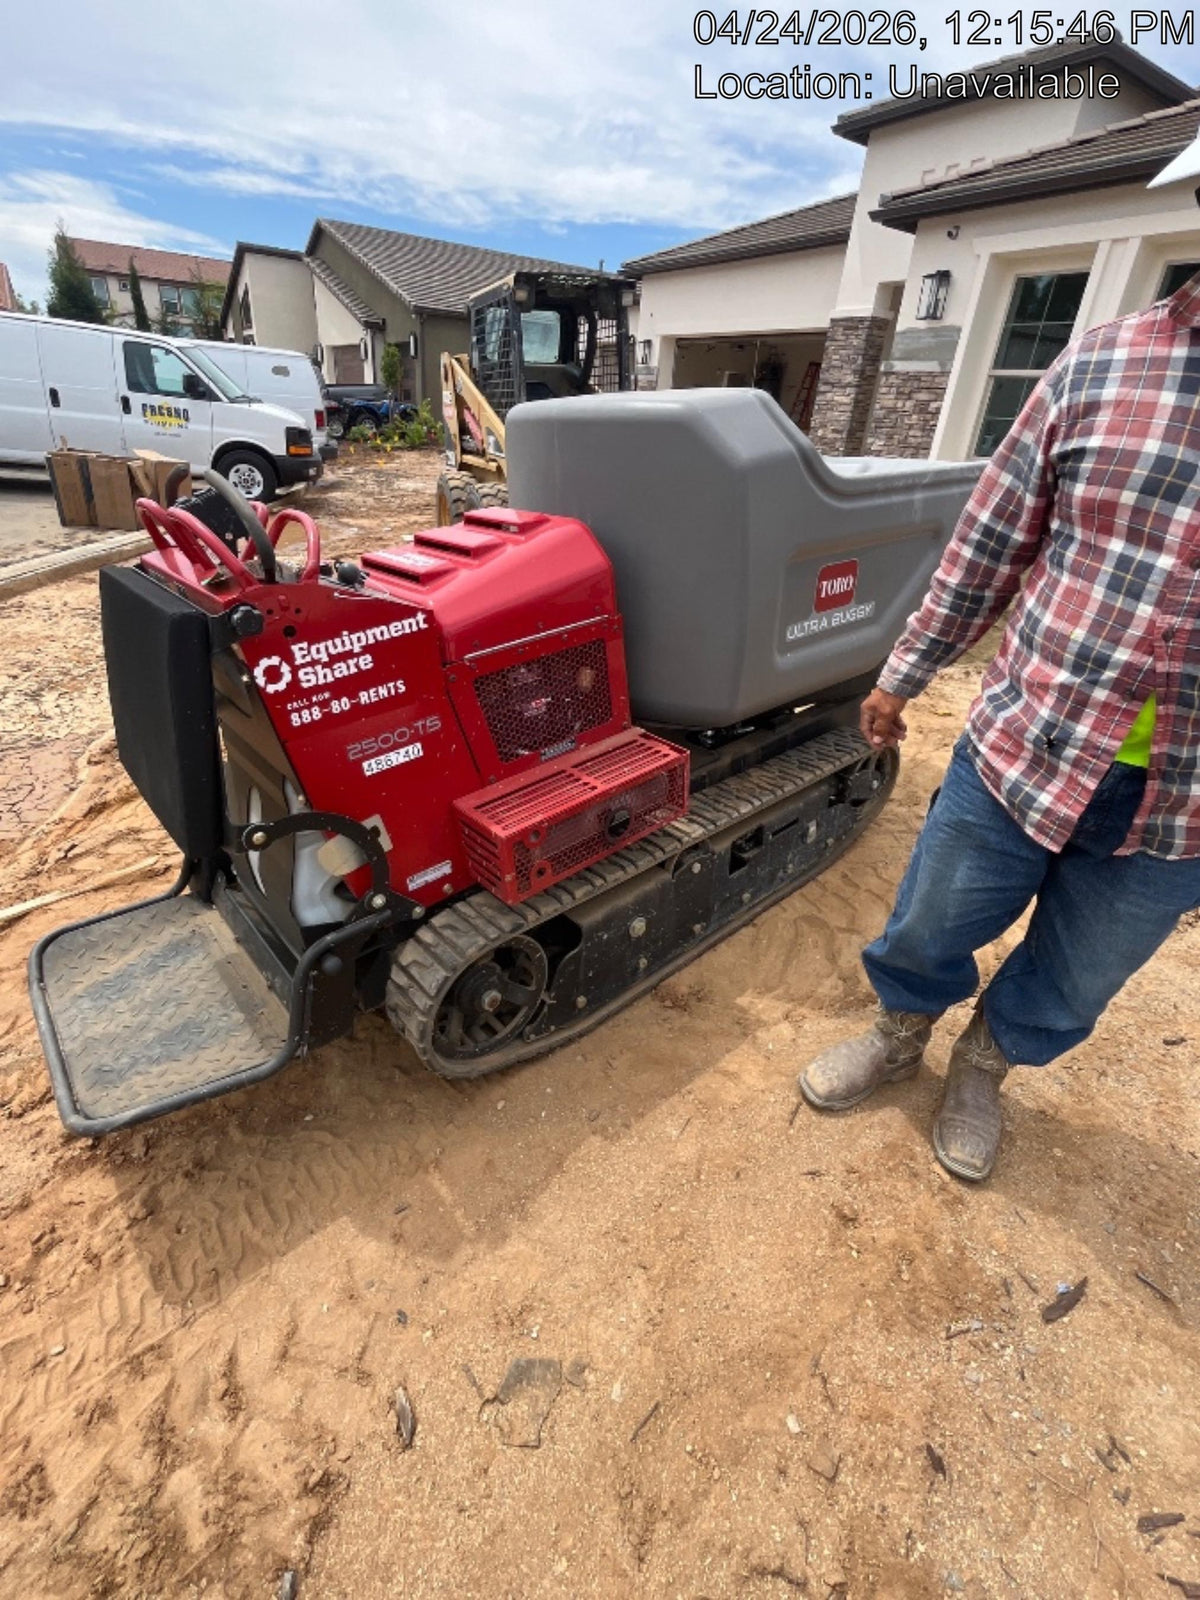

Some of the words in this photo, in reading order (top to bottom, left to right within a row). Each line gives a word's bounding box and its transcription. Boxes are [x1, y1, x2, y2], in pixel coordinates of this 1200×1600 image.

[820, 574, 854, 598] TORO
[290, 610, 429, 666] Equipment
[786, 616, 828, 640] ULTRA
[831, 601, 876, 627] BUGGY
[297, 653, 374, 689] Share
[286, 697, 310, 711] CALL
[290, 679, 407, 727] 888-80-RENTS
[365, 744, 421, 772] 486740
